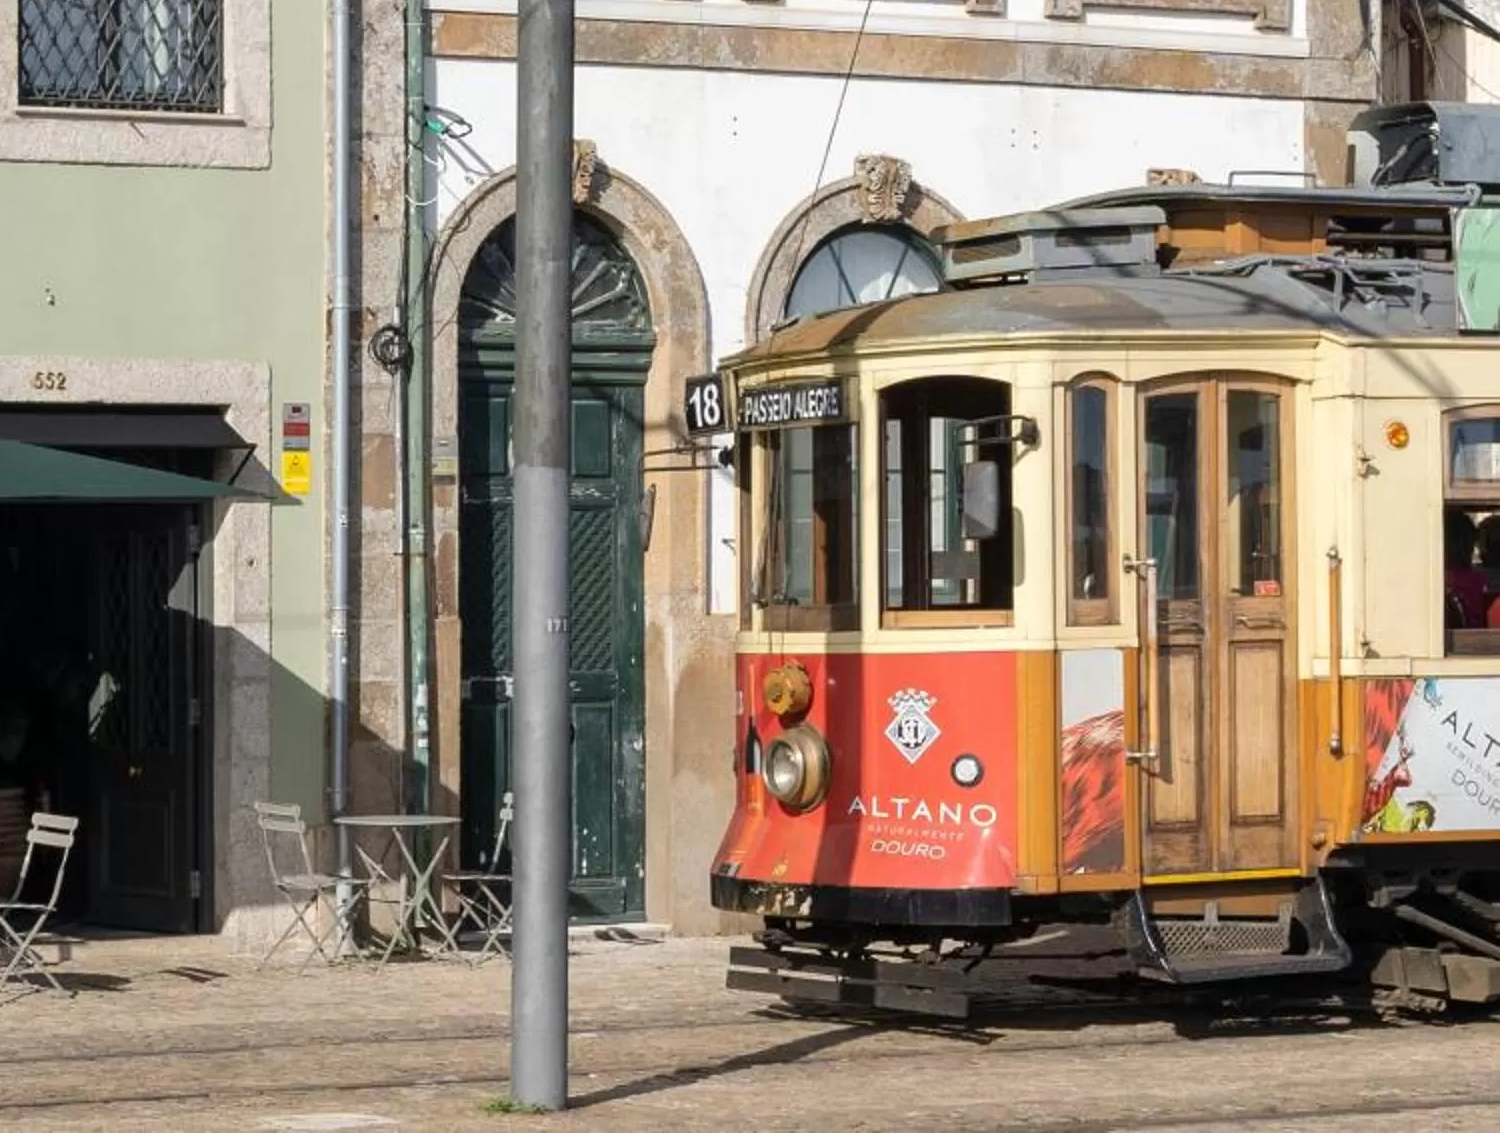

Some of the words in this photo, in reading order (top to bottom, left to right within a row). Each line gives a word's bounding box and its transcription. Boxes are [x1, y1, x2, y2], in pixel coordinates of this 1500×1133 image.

[33, 371, 67, 391] 552
[689, 383, 721, 428] 18
[744, 391, 791, 424] PASSEIO
[793, 386, 839, 420] ALEGRE
[1441, 709, 1500, 768] ALT
[848, 794, 998, 828] ALTANO
[870, 839, 946, 861] DOURO
